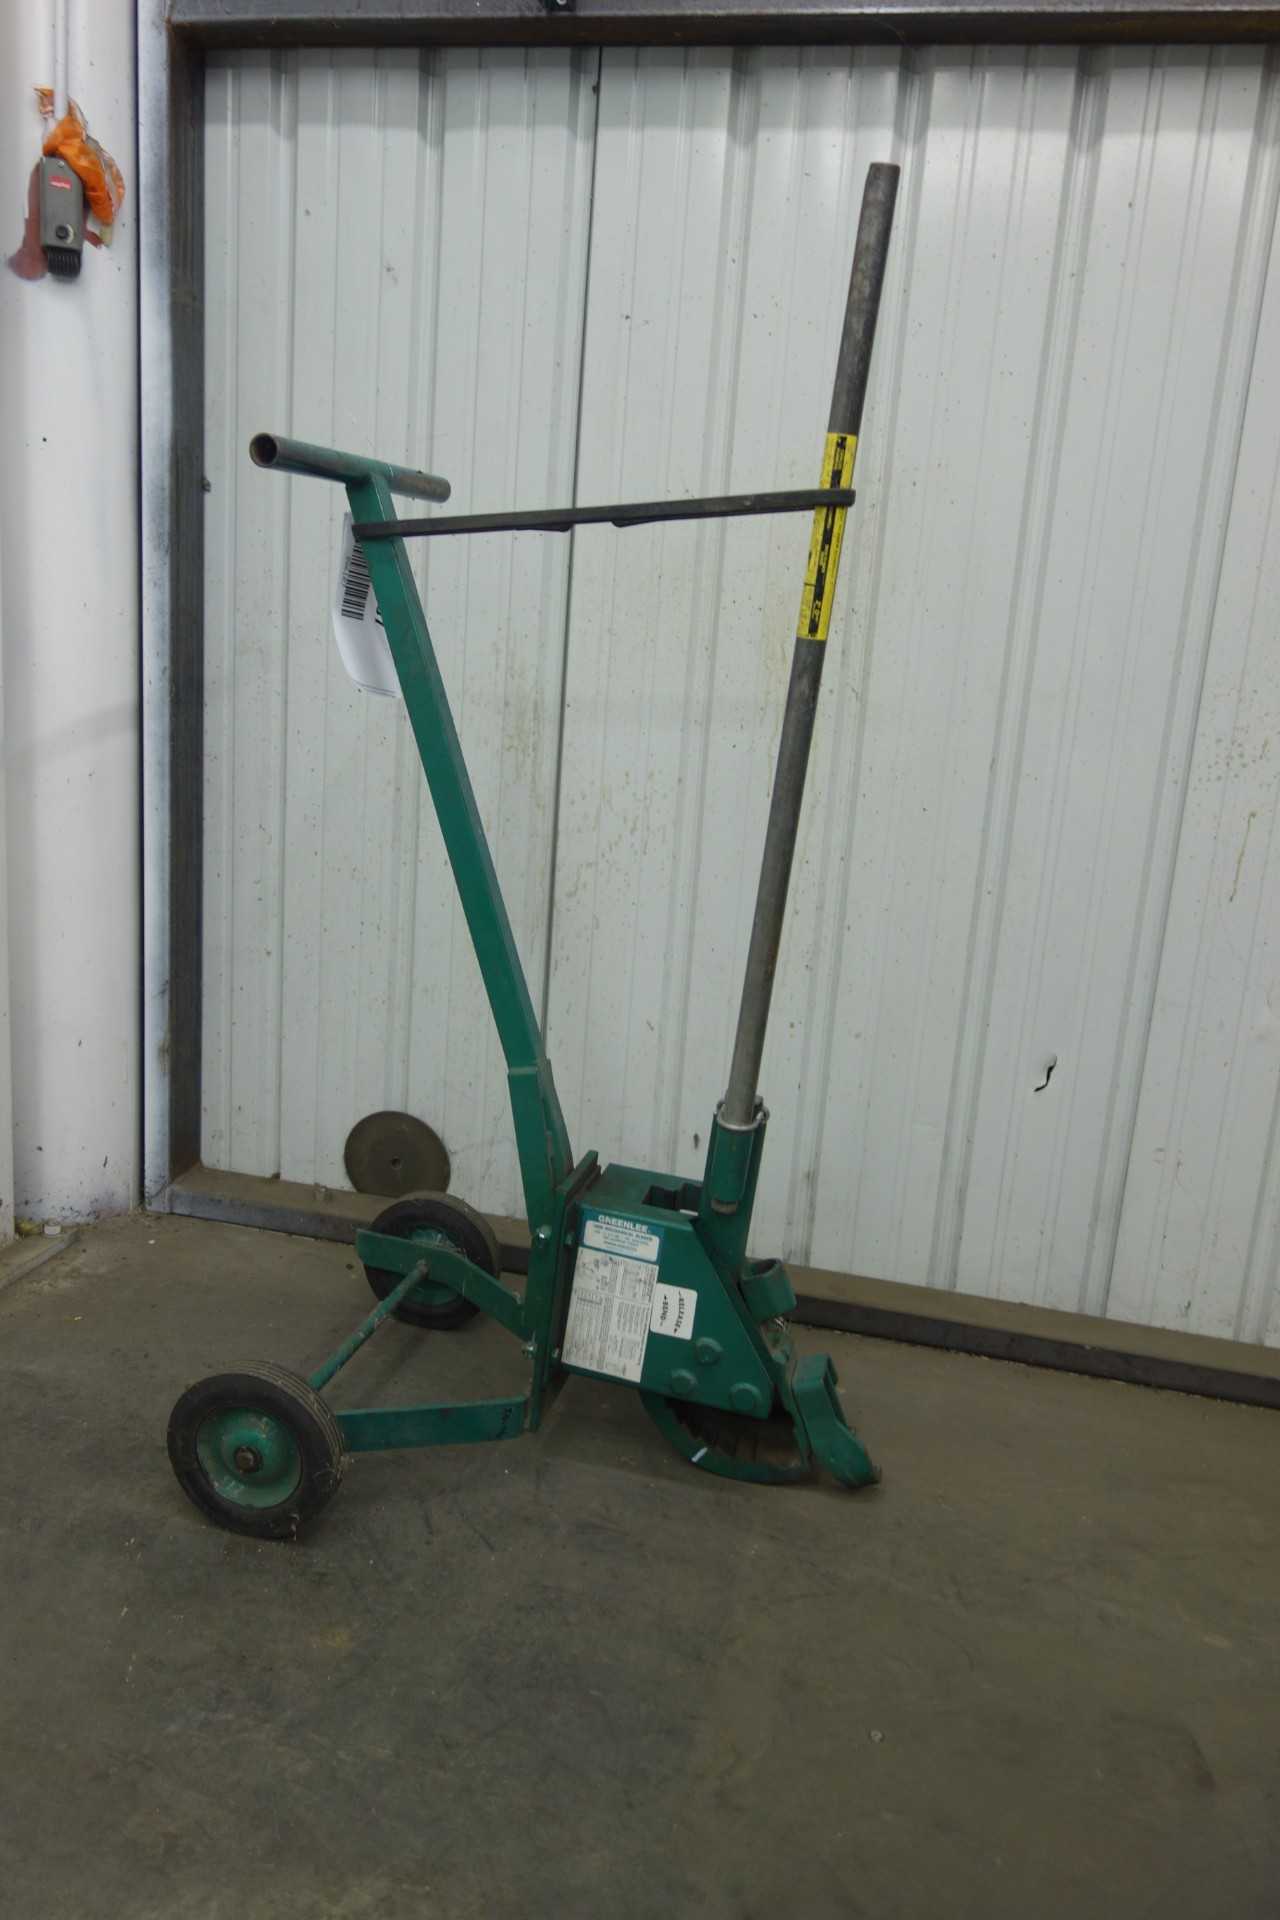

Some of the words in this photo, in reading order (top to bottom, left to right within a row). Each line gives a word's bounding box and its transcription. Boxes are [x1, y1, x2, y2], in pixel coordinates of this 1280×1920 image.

[598, 1215, 649, 1234] GREENLEE
[660, 1301, 669, 1321] BEND
[675, 1297, 685, 1328] RELEASE
